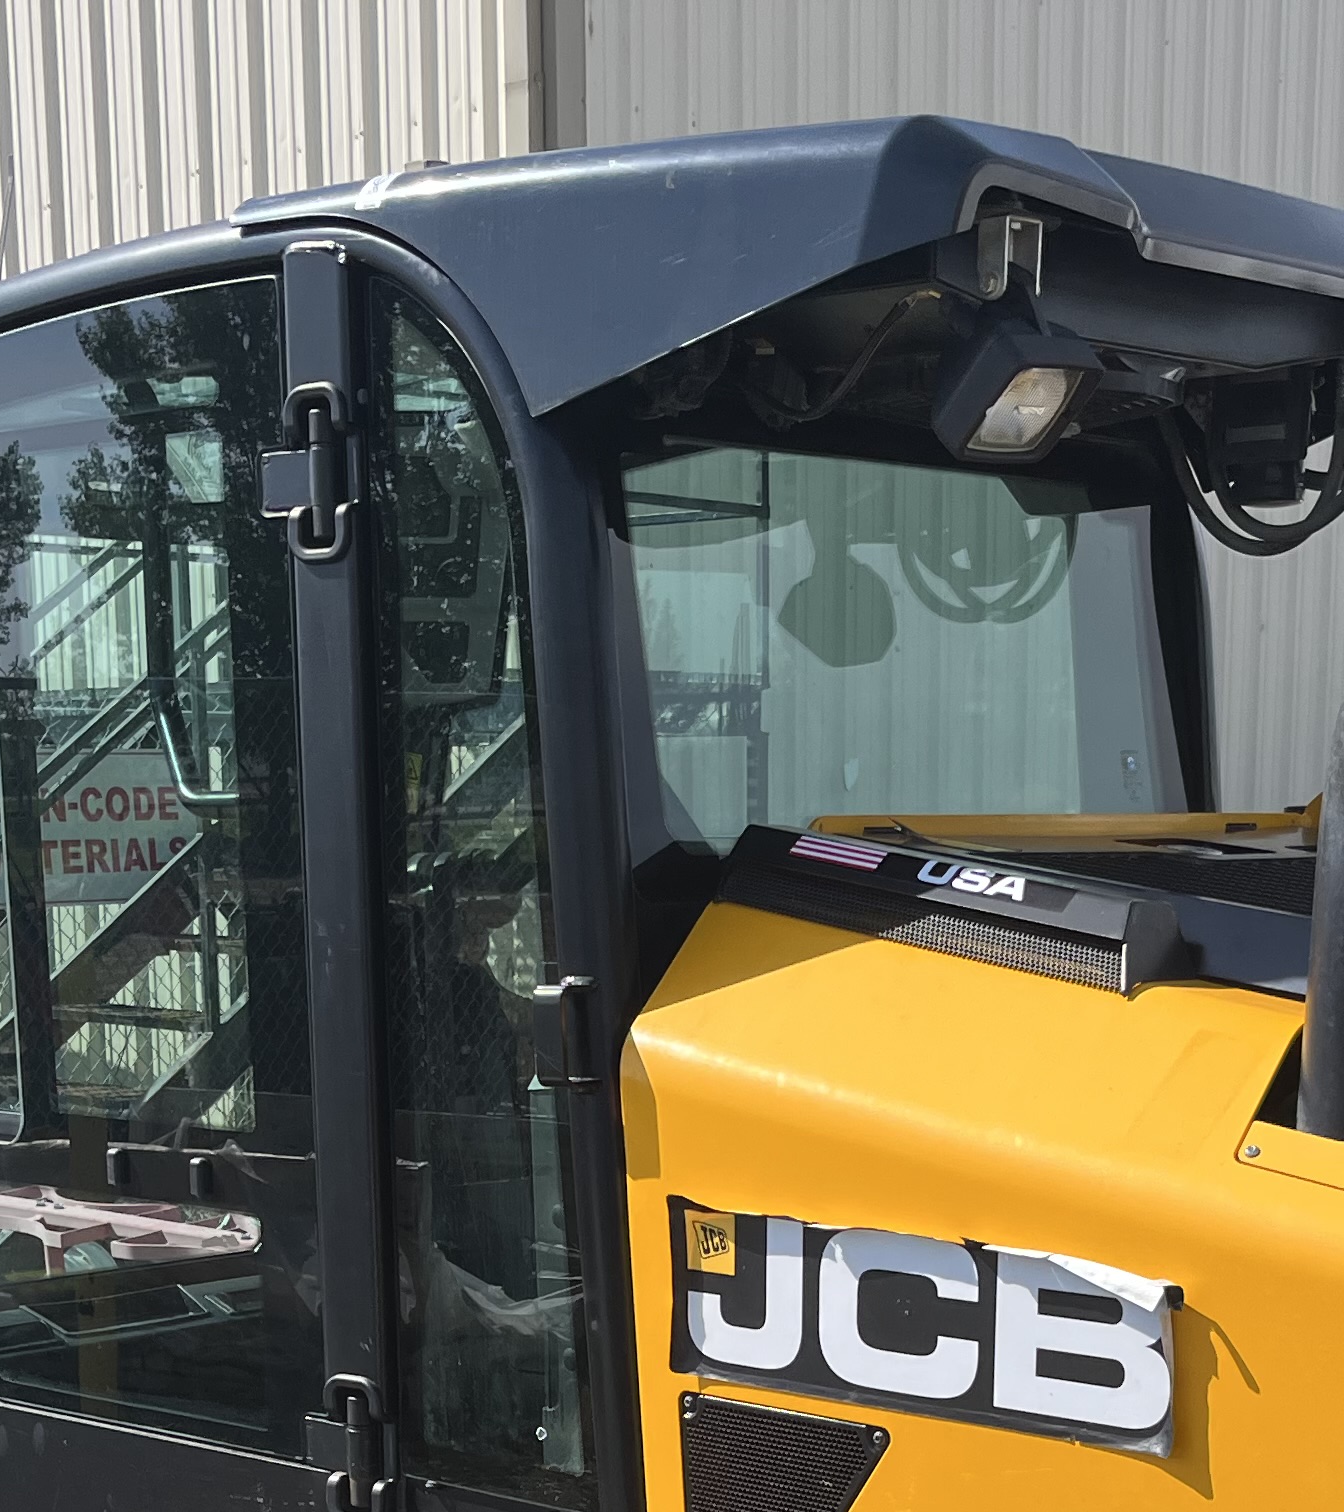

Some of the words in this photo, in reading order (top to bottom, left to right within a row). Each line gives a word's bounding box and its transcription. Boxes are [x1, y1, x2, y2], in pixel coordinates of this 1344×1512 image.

[915, 859, 1027, 903] USA
[700, 1225, 727, 1255] JCB
[687, 1215, 1171, 1430] JCB
